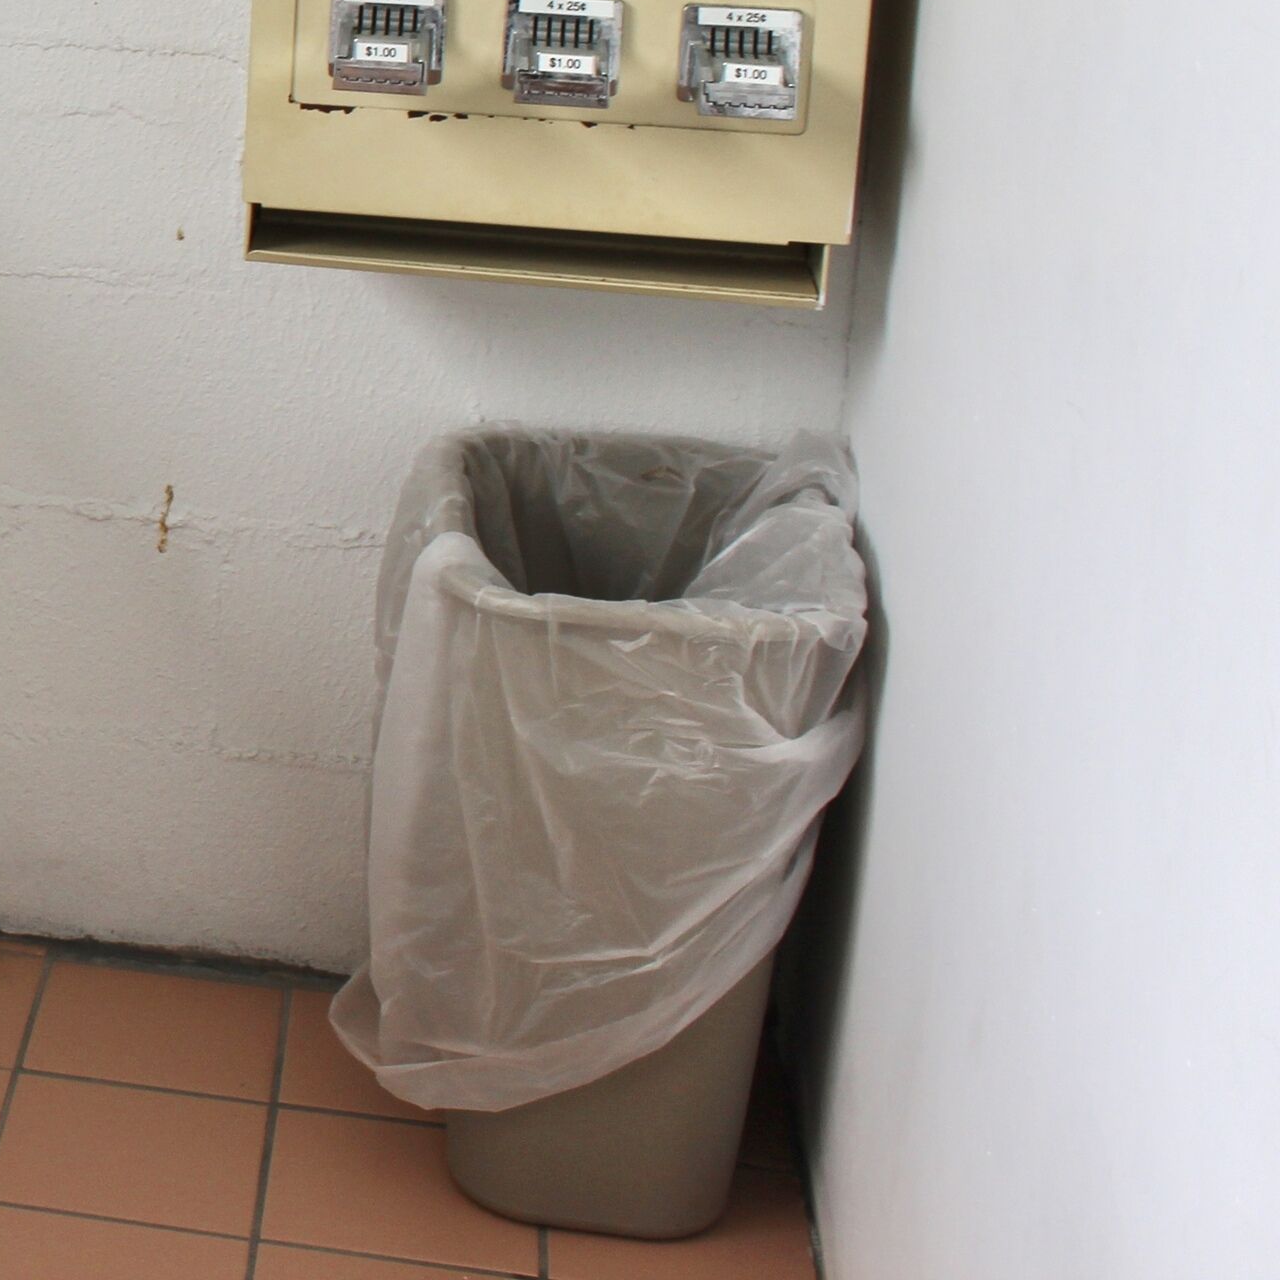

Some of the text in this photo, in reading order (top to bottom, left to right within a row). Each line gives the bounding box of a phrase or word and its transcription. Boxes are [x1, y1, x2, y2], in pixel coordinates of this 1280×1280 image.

[547, 0, 554, 9] 4
[566, 1, 586, 11] 25¢
[726, 12, 733, 21] 4
[746, 12, 767, 23] 25¢
[365, 46, 397, 58] $1.00
[549, 57, 581, 69] $1.00
[734, 68, 767, 80] $1.00
